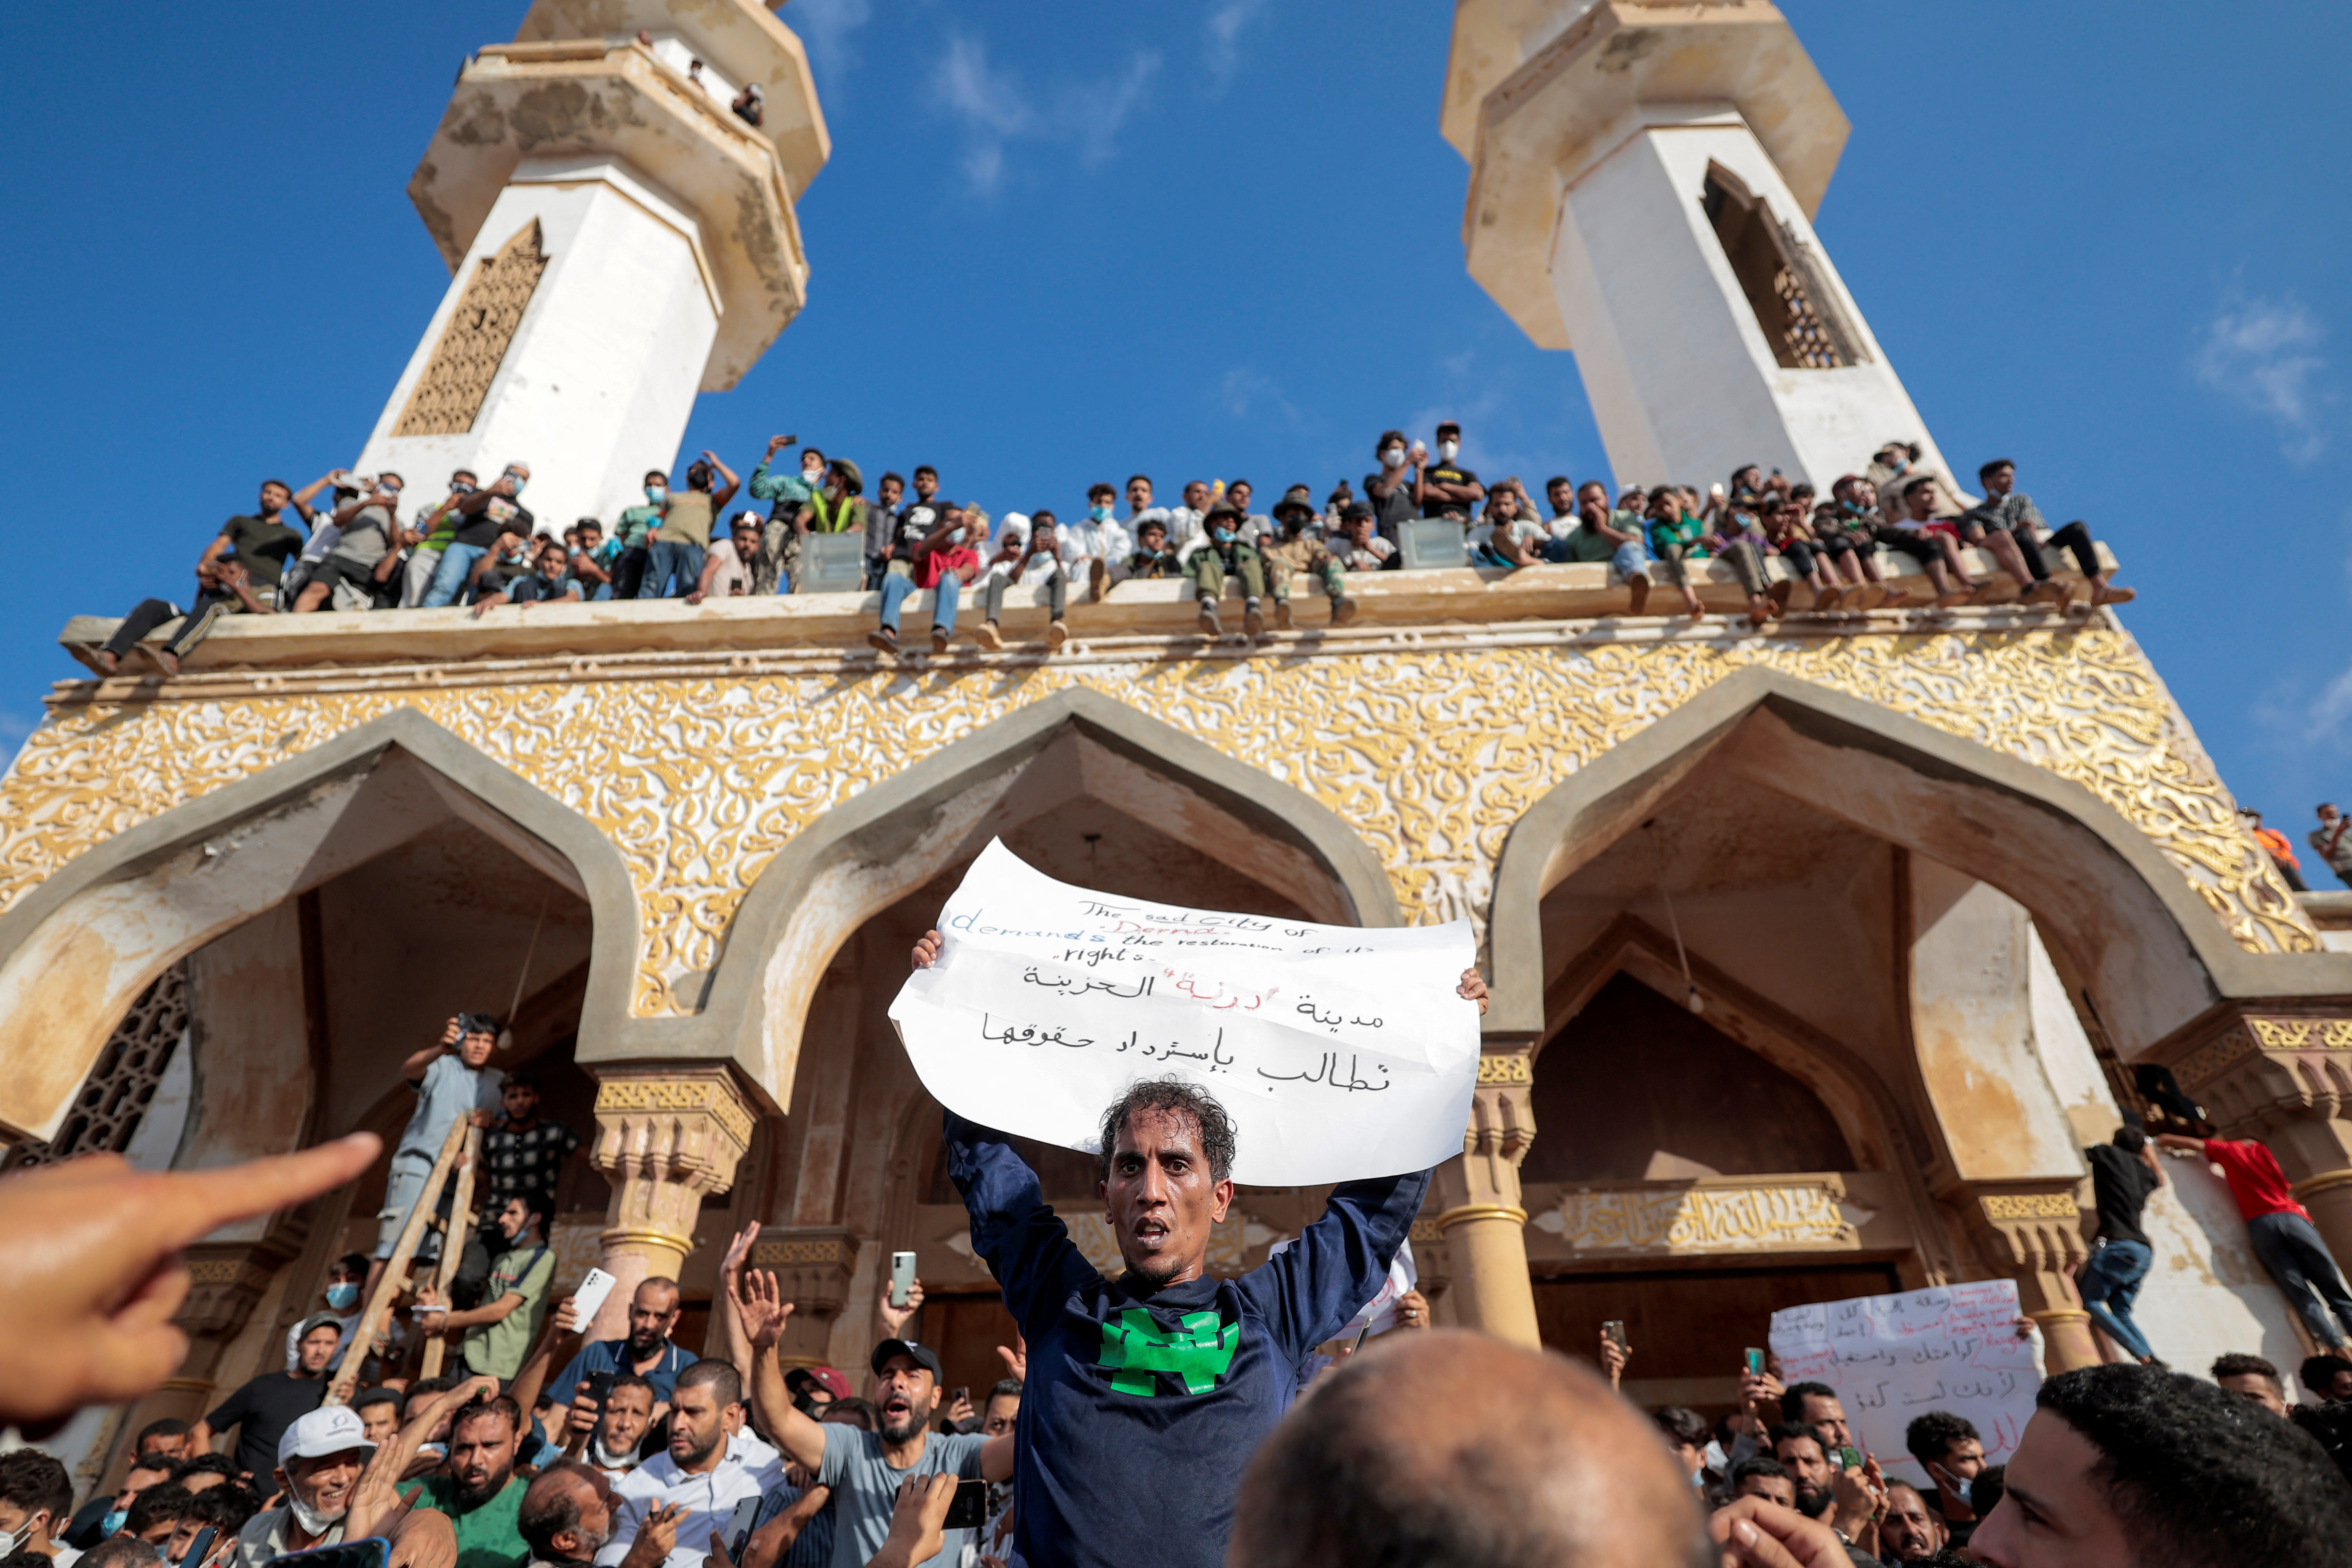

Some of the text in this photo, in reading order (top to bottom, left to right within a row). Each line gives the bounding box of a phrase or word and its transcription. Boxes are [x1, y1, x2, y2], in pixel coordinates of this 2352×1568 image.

[951, 908, 1105, 942] demands
[1122, 936, 1163, 946] the
[1178, 939, 1283, 951] restoration
[1078, 901, 1140, 918] The
[1145, 914, 1189, 922] sad
[1199, 917, 1272, 931] City
[1024, 966, 1155, 998] الحزينة
[1297, 995, 1383, 1033] مدينة
[983, 1013, 1095, 1047] حقوقها
[1257, 1052, 1390, 1093] تطالب
[1713, 1189, 1764, 1239] الله
[1838, 1301, 1863, 1322] كل
[1915, 1296, 1950, 1313] رسالة
[1911, 1337, 1979, 1365] كرامتك
[1901, 1380, 1946, 1406] لست
[1952, 1372, 2016, 1399] لأنك
